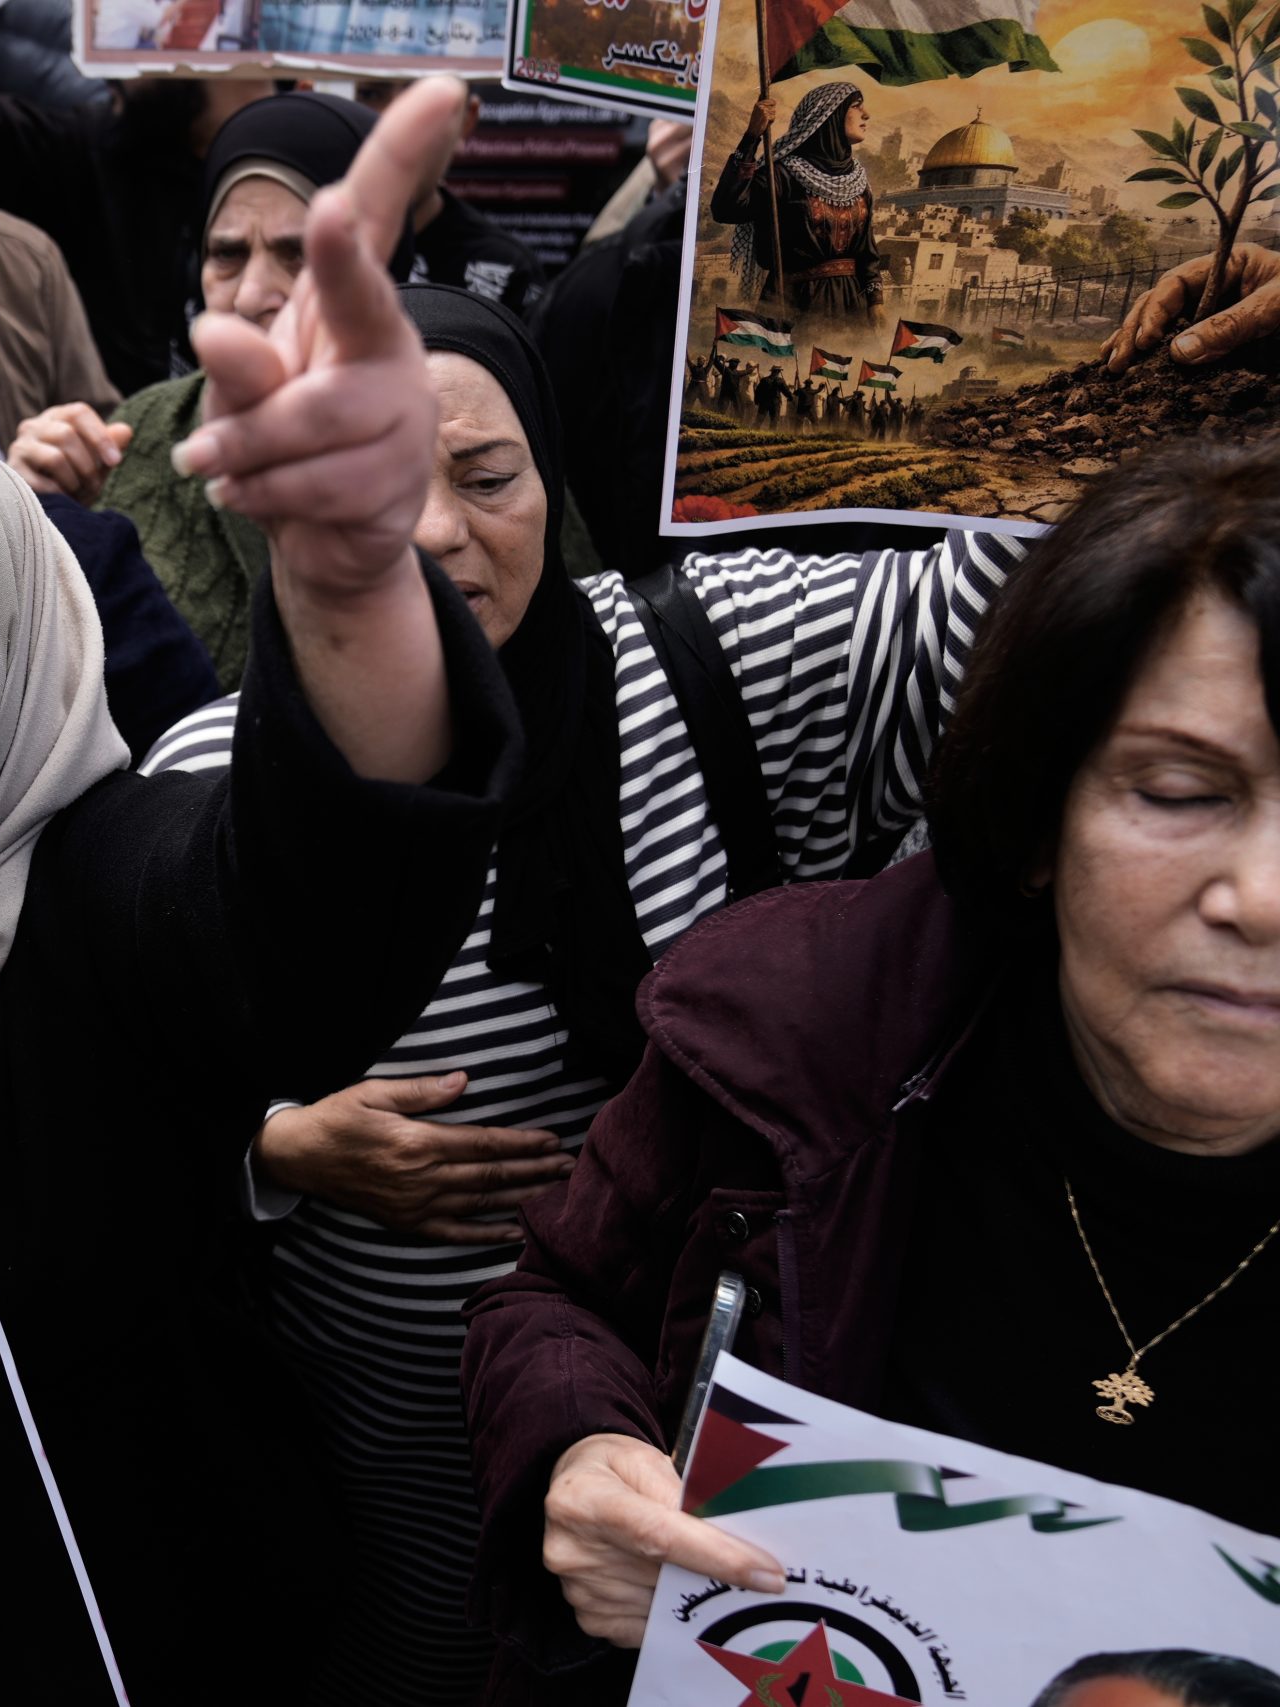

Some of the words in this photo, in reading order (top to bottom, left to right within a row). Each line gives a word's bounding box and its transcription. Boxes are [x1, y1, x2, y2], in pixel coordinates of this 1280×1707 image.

[516, 56, 561, 84] 2025
[601, 39, 690, 84] ينكسر
[927, 1642, 967, 1700] الجبهة
